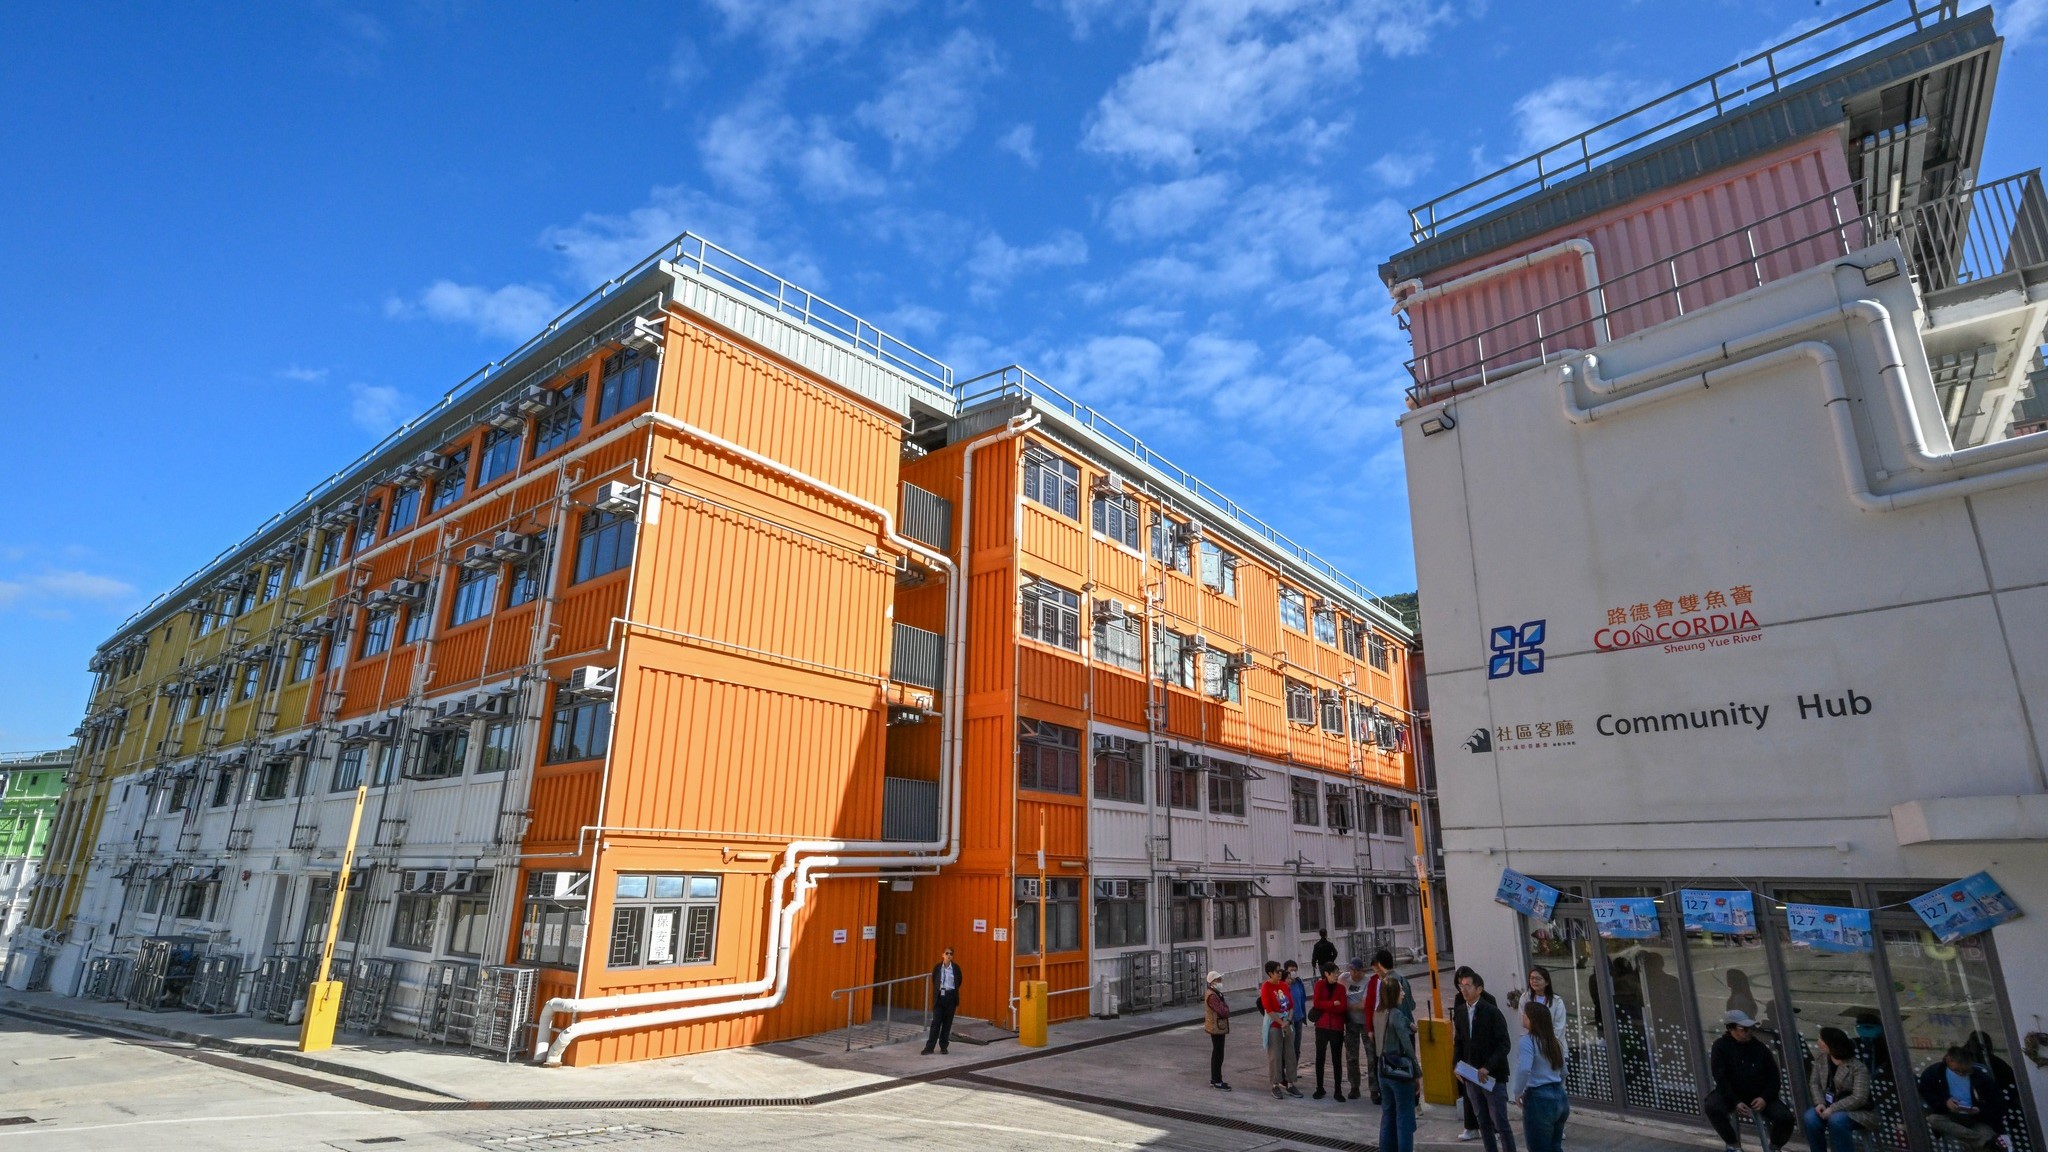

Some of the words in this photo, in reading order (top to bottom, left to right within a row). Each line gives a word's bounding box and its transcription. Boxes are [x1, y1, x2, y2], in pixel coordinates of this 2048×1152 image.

[1607, 585, 1753, 626] 路德會雙魚薈
[1594, 610, 1759, 649] CONCORDIA
[1664, 641, 1705, 654] Sheung
[1708, 637, 1730, 647] Yue
[1733, 632, 1763, 644] River
[1496, 720, 1575, 742] 社區客廳
[1596, 702, 1769, 736] Community
[1797, 689, 1872, 720] Hub
